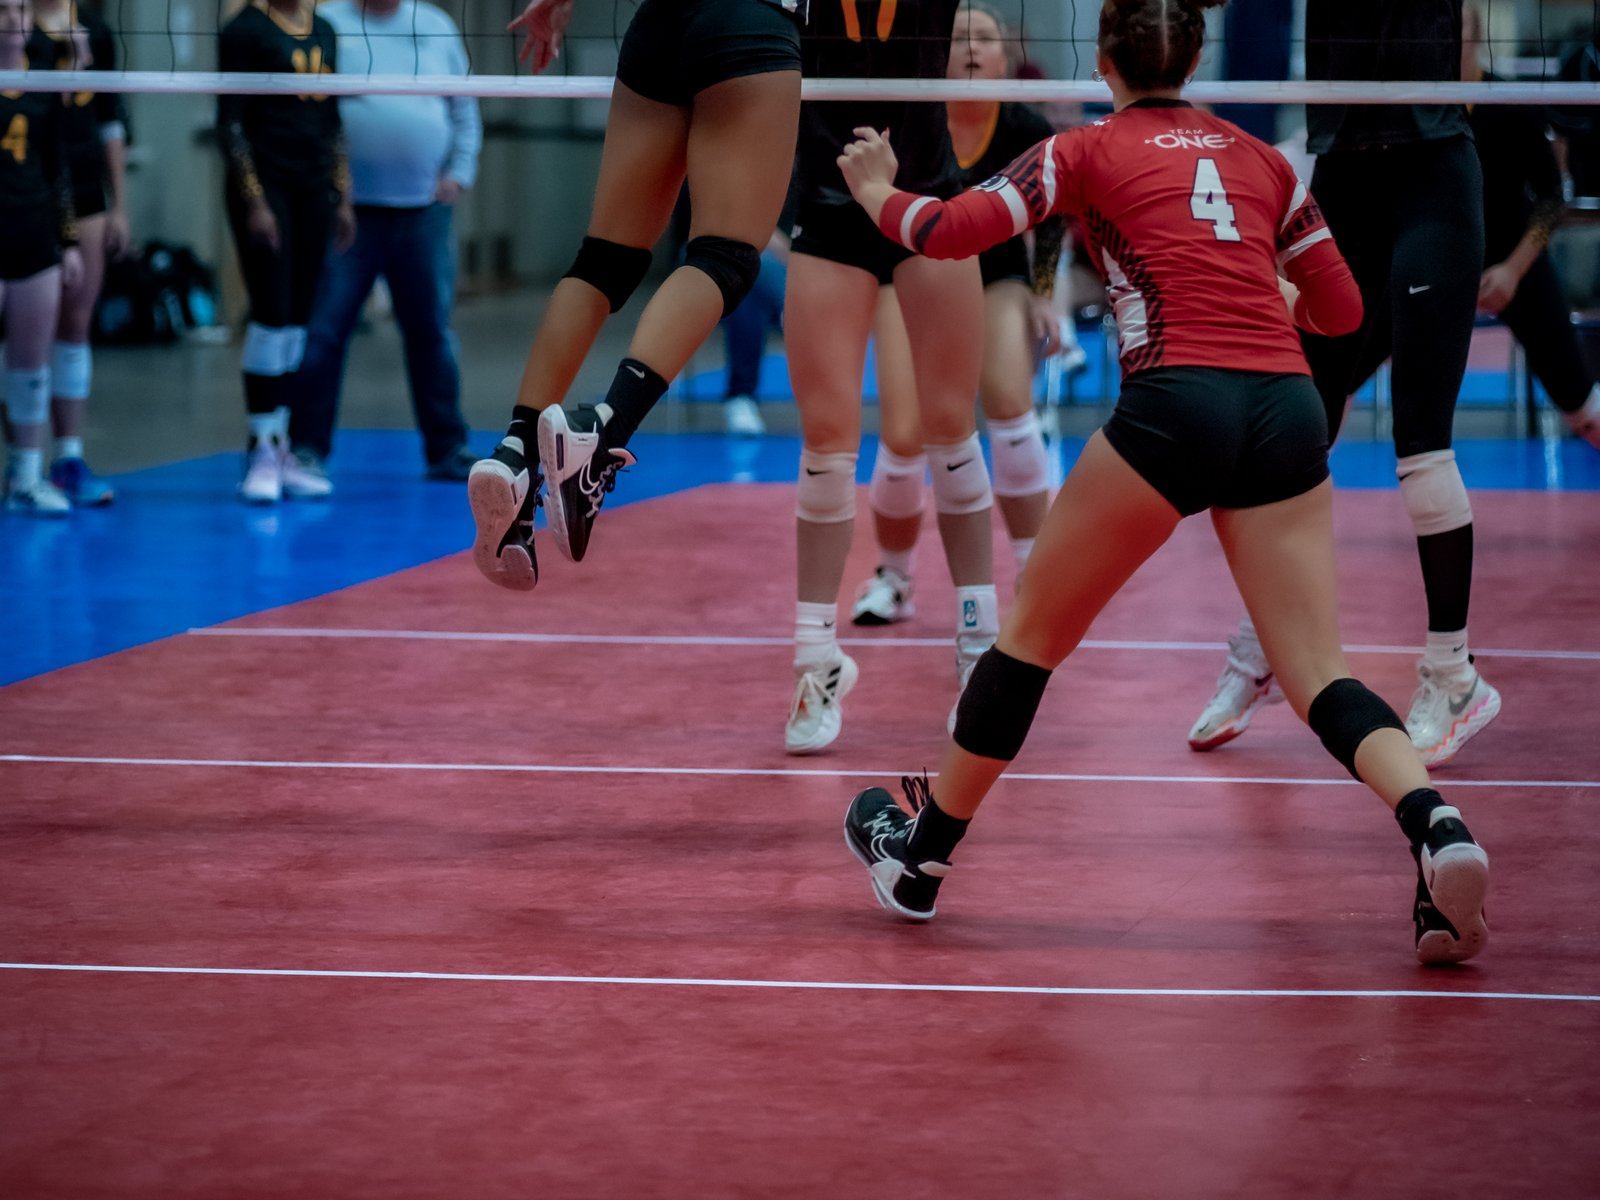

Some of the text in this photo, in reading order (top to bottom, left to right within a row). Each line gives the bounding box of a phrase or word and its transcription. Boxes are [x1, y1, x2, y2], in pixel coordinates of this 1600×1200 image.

[0, 112, 30, 165] 4
[1153, 133, 1228, 150] ONE
[1189, 157, 1242, 243] 4
